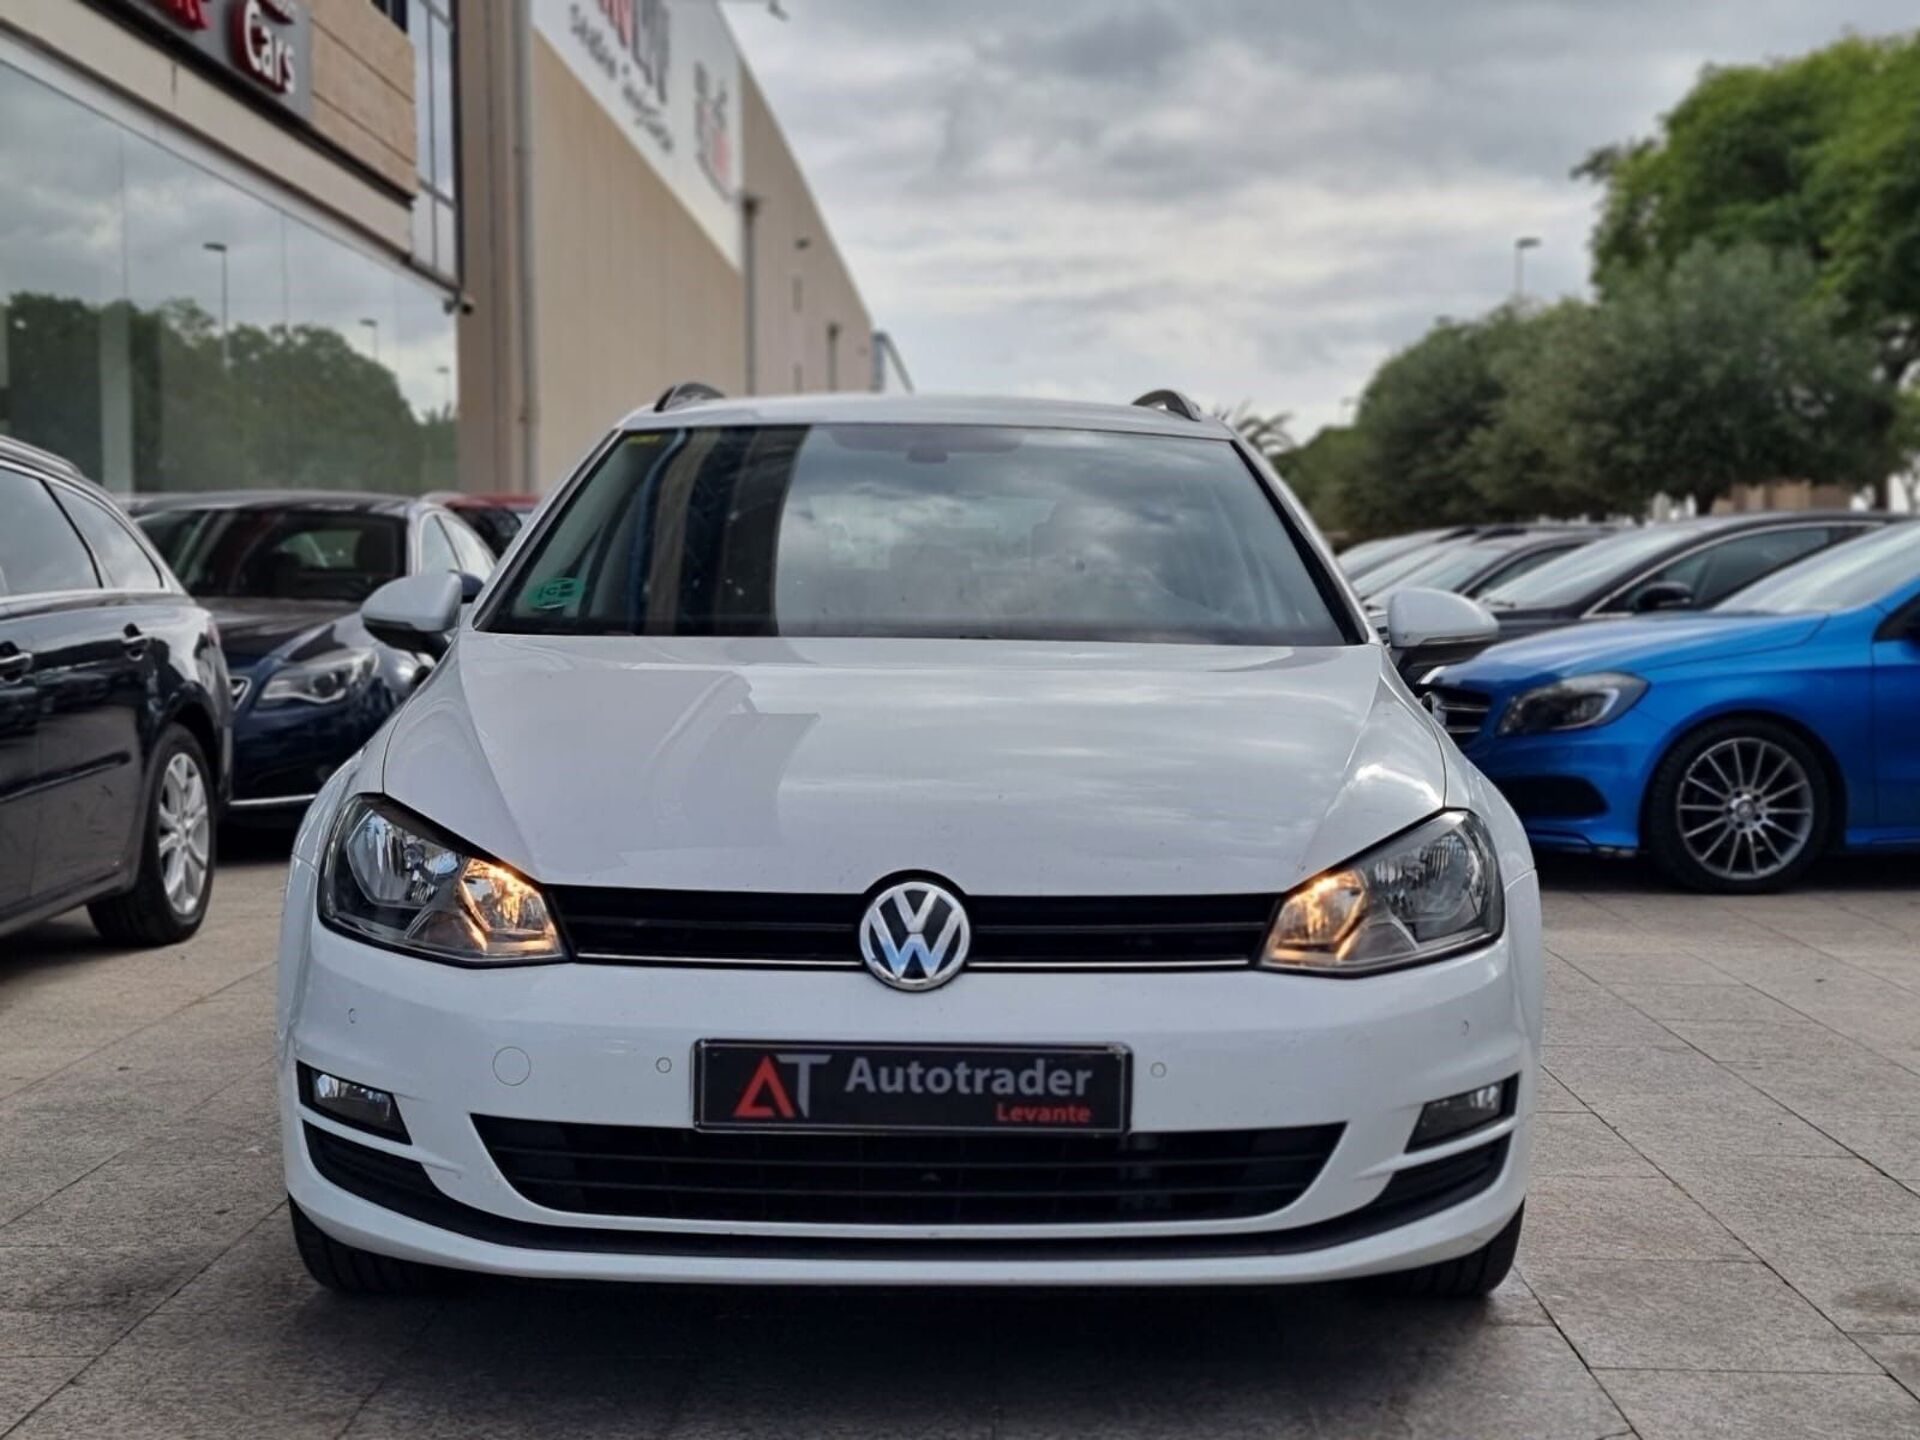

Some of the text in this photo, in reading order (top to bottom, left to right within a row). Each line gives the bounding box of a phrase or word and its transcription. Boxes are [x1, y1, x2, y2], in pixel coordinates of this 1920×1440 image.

[244, 0, 296, 94] Cars
[733, 1053, 1092, 1118] AT Autotrader
[996, 1103, 1092, 1123] Levante
